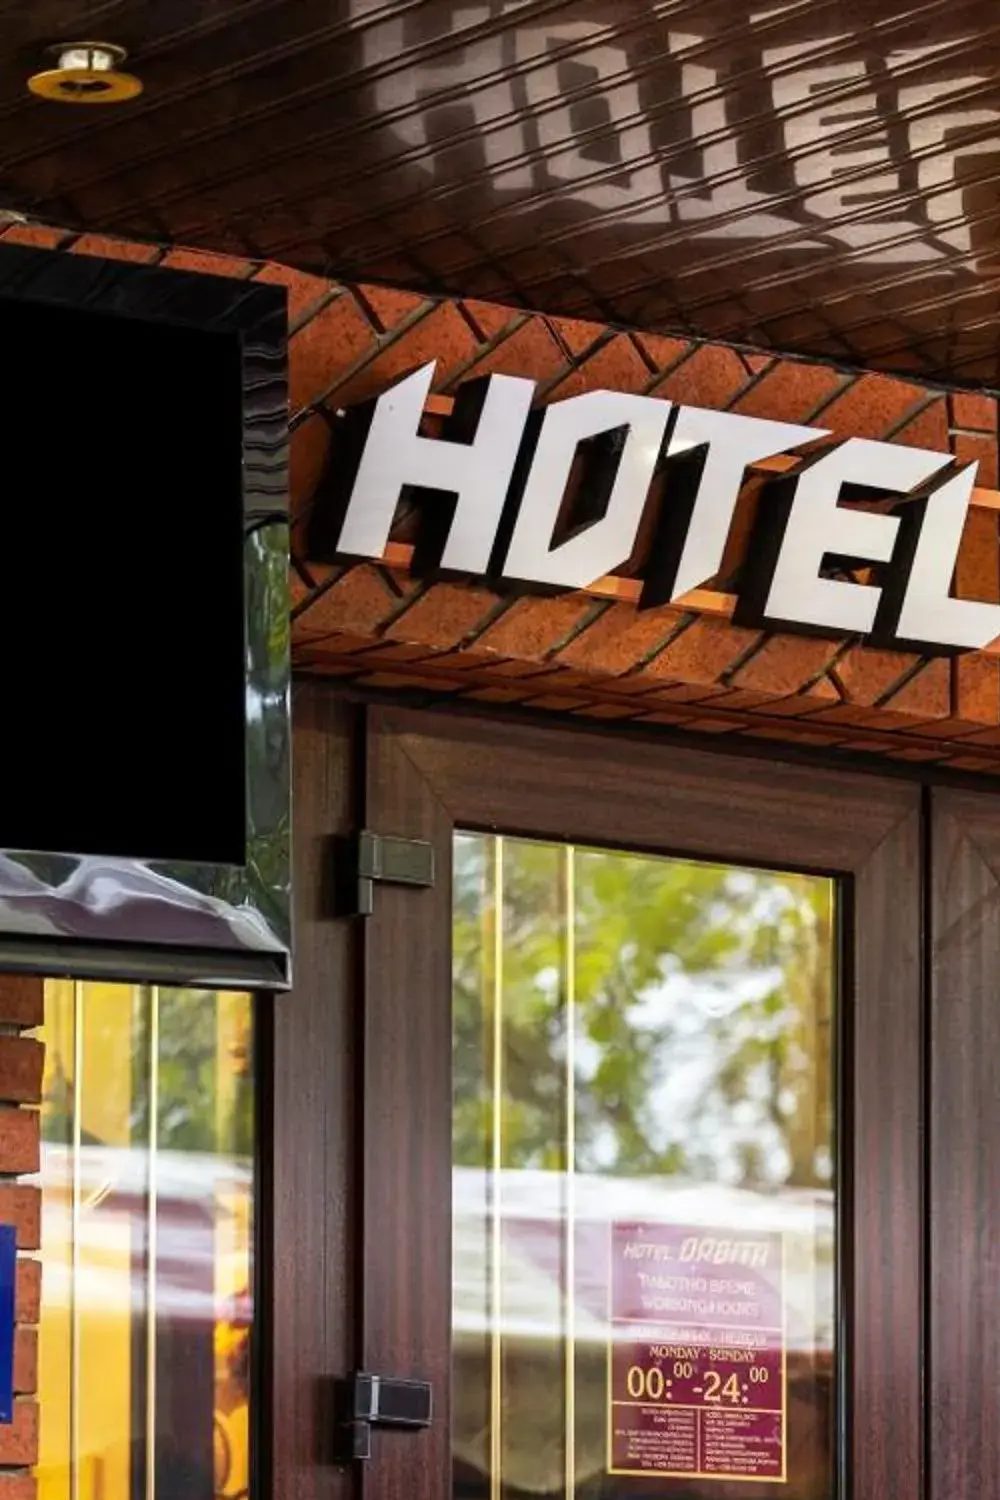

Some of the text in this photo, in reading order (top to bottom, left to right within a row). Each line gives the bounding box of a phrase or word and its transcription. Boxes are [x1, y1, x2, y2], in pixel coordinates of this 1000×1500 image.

[623, 1236, 770, 1268] HOTEL ORBITA
[650, 1345, 701, 1361] MONDAY
[709, 1350, 757, 1364] SUNDAY
